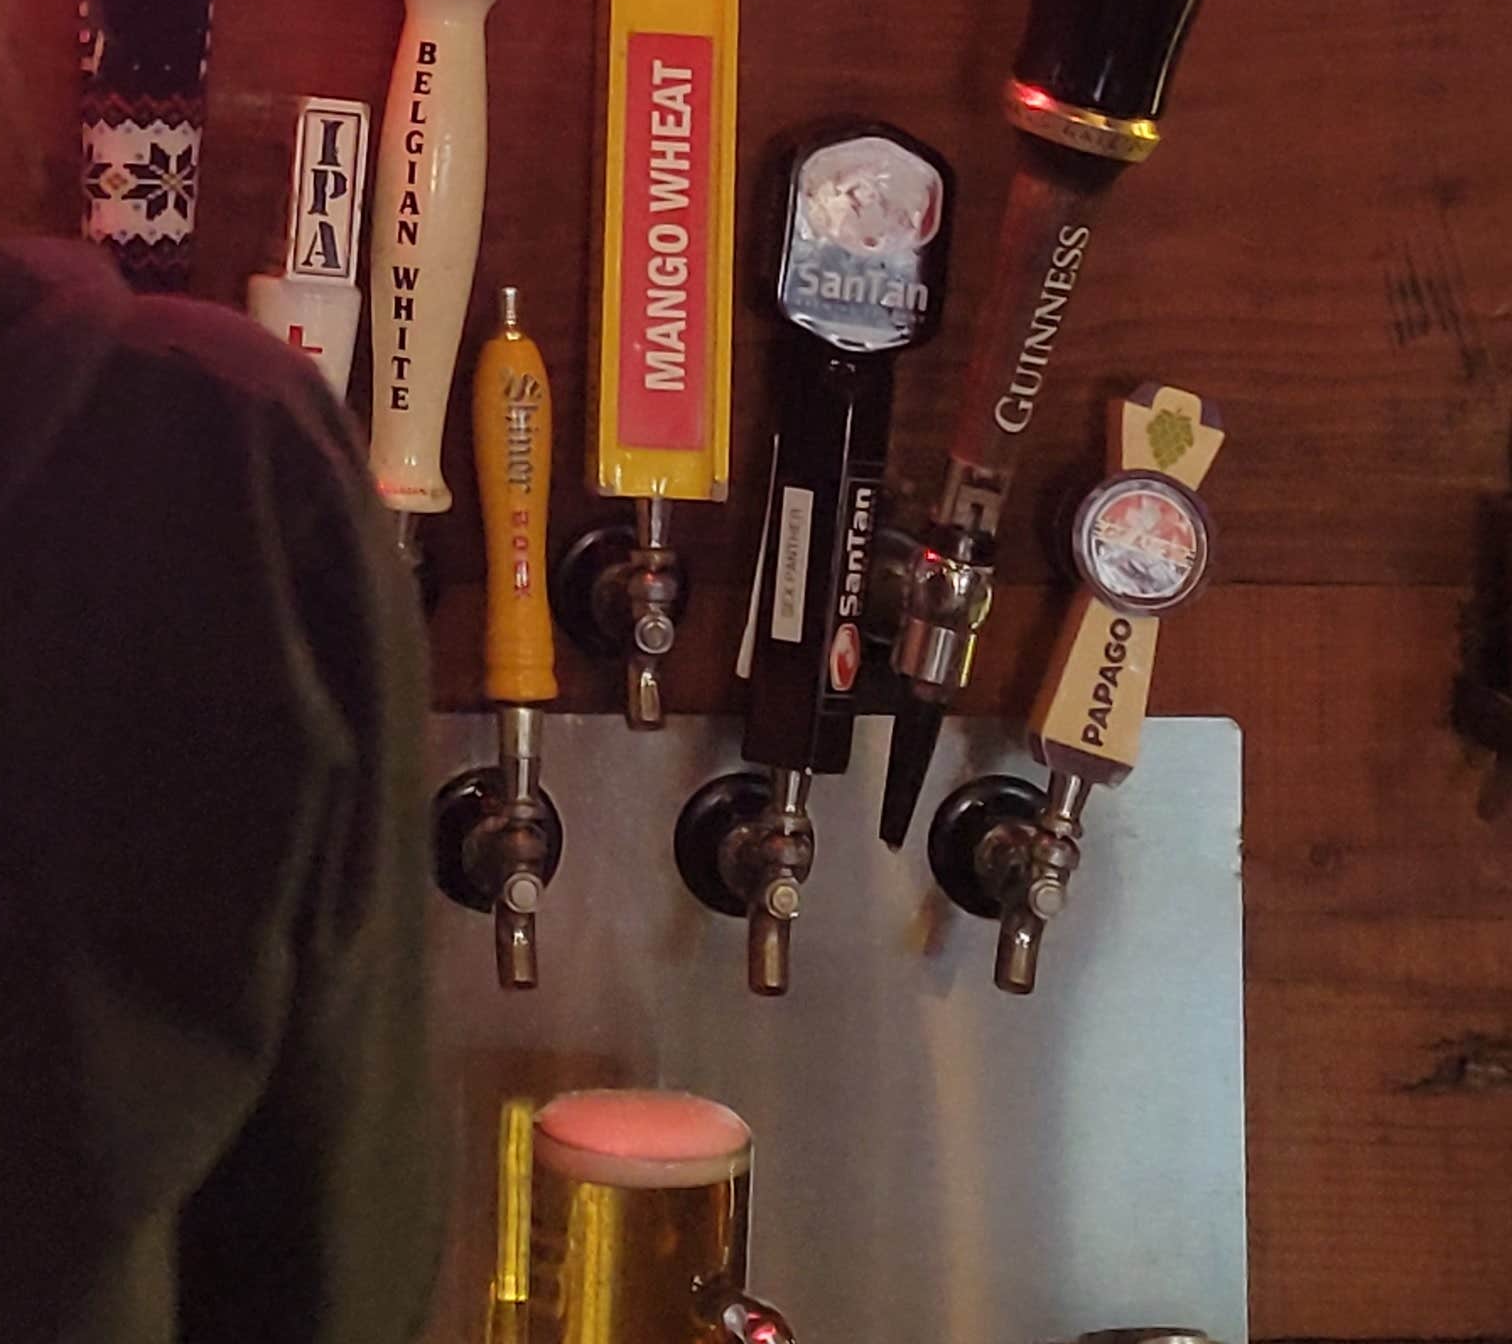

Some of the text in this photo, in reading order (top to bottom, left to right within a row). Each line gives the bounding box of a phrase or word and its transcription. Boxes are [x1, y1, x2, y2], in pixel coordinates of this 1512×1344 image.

[301, 119, 348, 269] IPA
[390, 41, 438, 411] BELGIAN WHITE
[644, 59, 693, 392] MANGO WHEAT
[797, 263, 929, 312] SanTan
[994, 224, 1091, 433] GUINNESS
[839, 487, 873, 617] SanTan
[1080, 618, 1132, 747] PAPAGO
